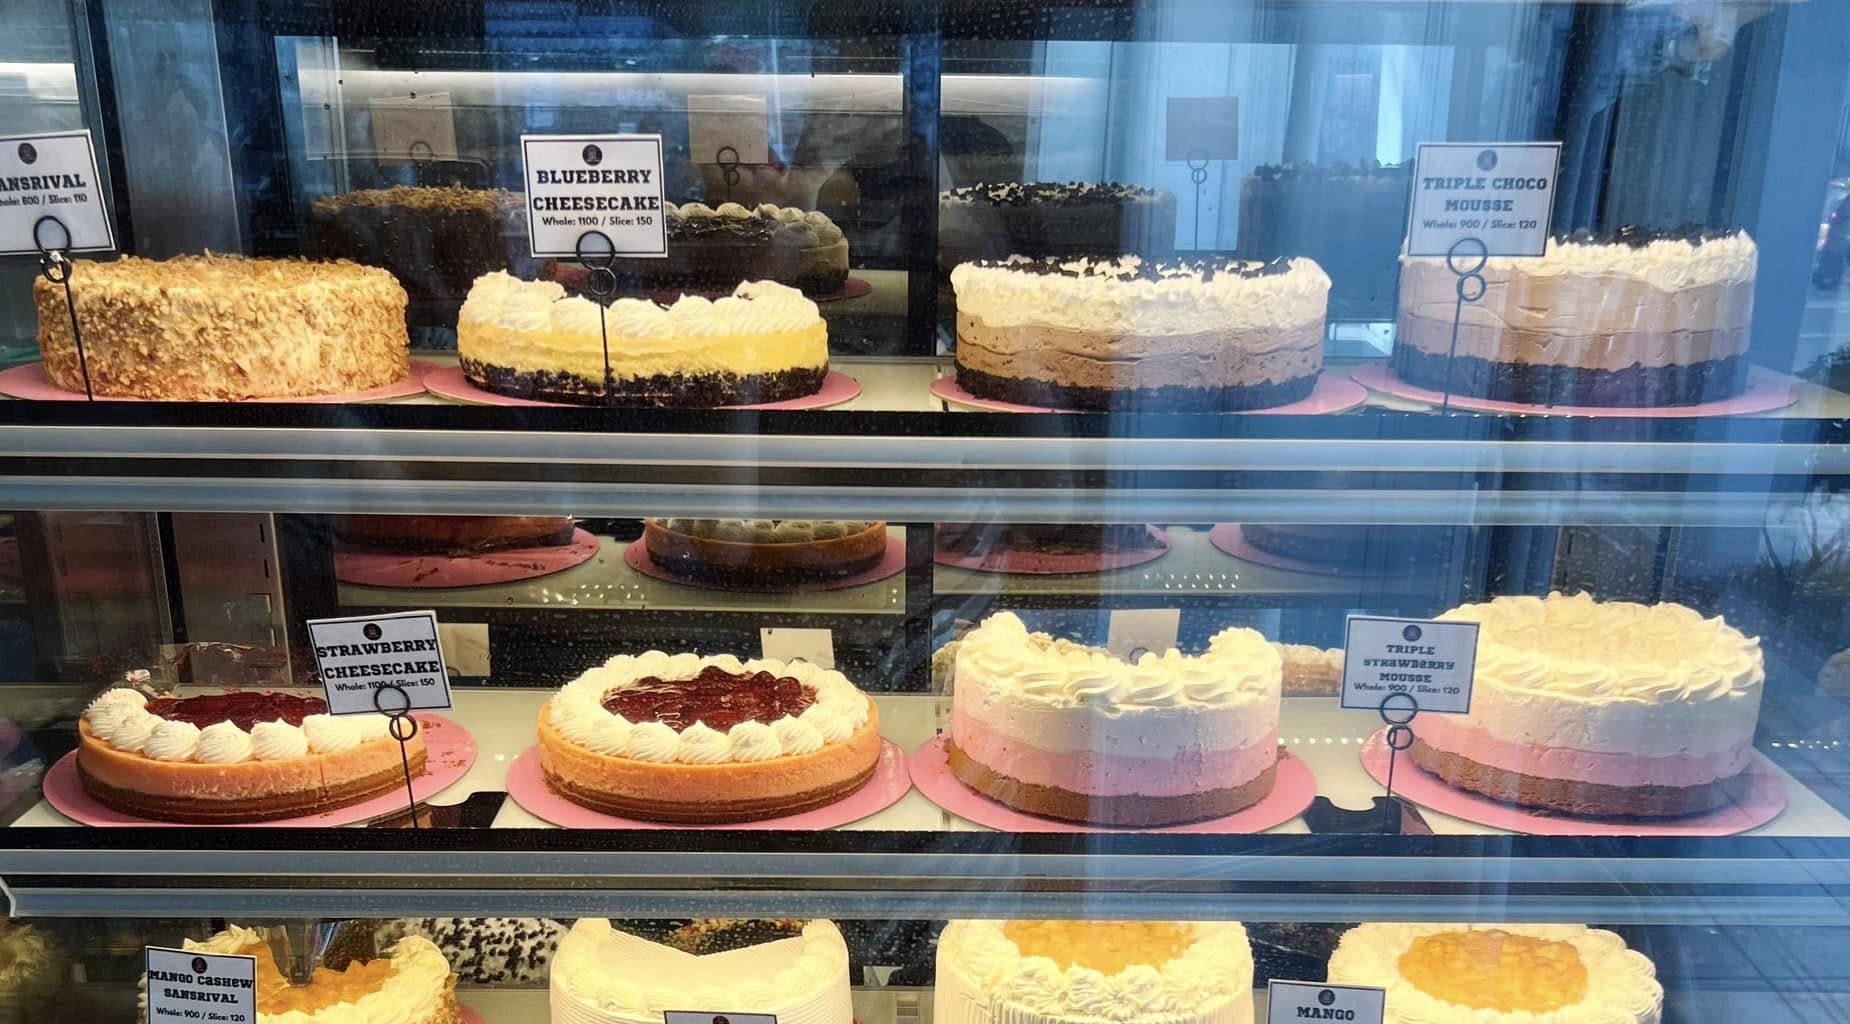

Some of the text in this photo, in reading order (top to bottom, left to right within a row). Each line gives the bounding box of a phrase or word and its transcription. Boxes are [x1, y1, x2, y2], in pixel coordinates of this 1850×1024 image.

[537, 170, 651, 184] BLUEBERRY
[1423, 177, 1547, 190] TRIPLE CHOCO
[22, 196, 40, 206] 800
[48, 194, 71, 205] Slice:
[74, 193, 88, 202] 110
[534, 196, 659, 210] CHEESECAKE
[1444, 200, 1514, 212] MOUSSE
[542, 216, 652, 226] Whole: 1100 / Slice: 150
[1423, 219, 1537, 230] Whole: 900 / Slice: 120
[316, 639, 436, 658] STRAWBERRY
[1386, 644, 1435, 655] TRIPLE
[324, 660, 440, 679] CHEESECAKE
[1380, 672, 1432, 683] MOUSSE
[335, 682, 366, 691] Whole:
[420, 678, 435, 686] 150
[1354, 682, 1460, 694] Whole: 900 / Slice: 120
[149, 970, 193, 983] MANGO
[164, 988, 238, 1003] SANSRIVAL
[156, 1007, 245, 1022] Whole: 900 / Slice: 120
[1297, 1006, 1355, 1021] MANGO
